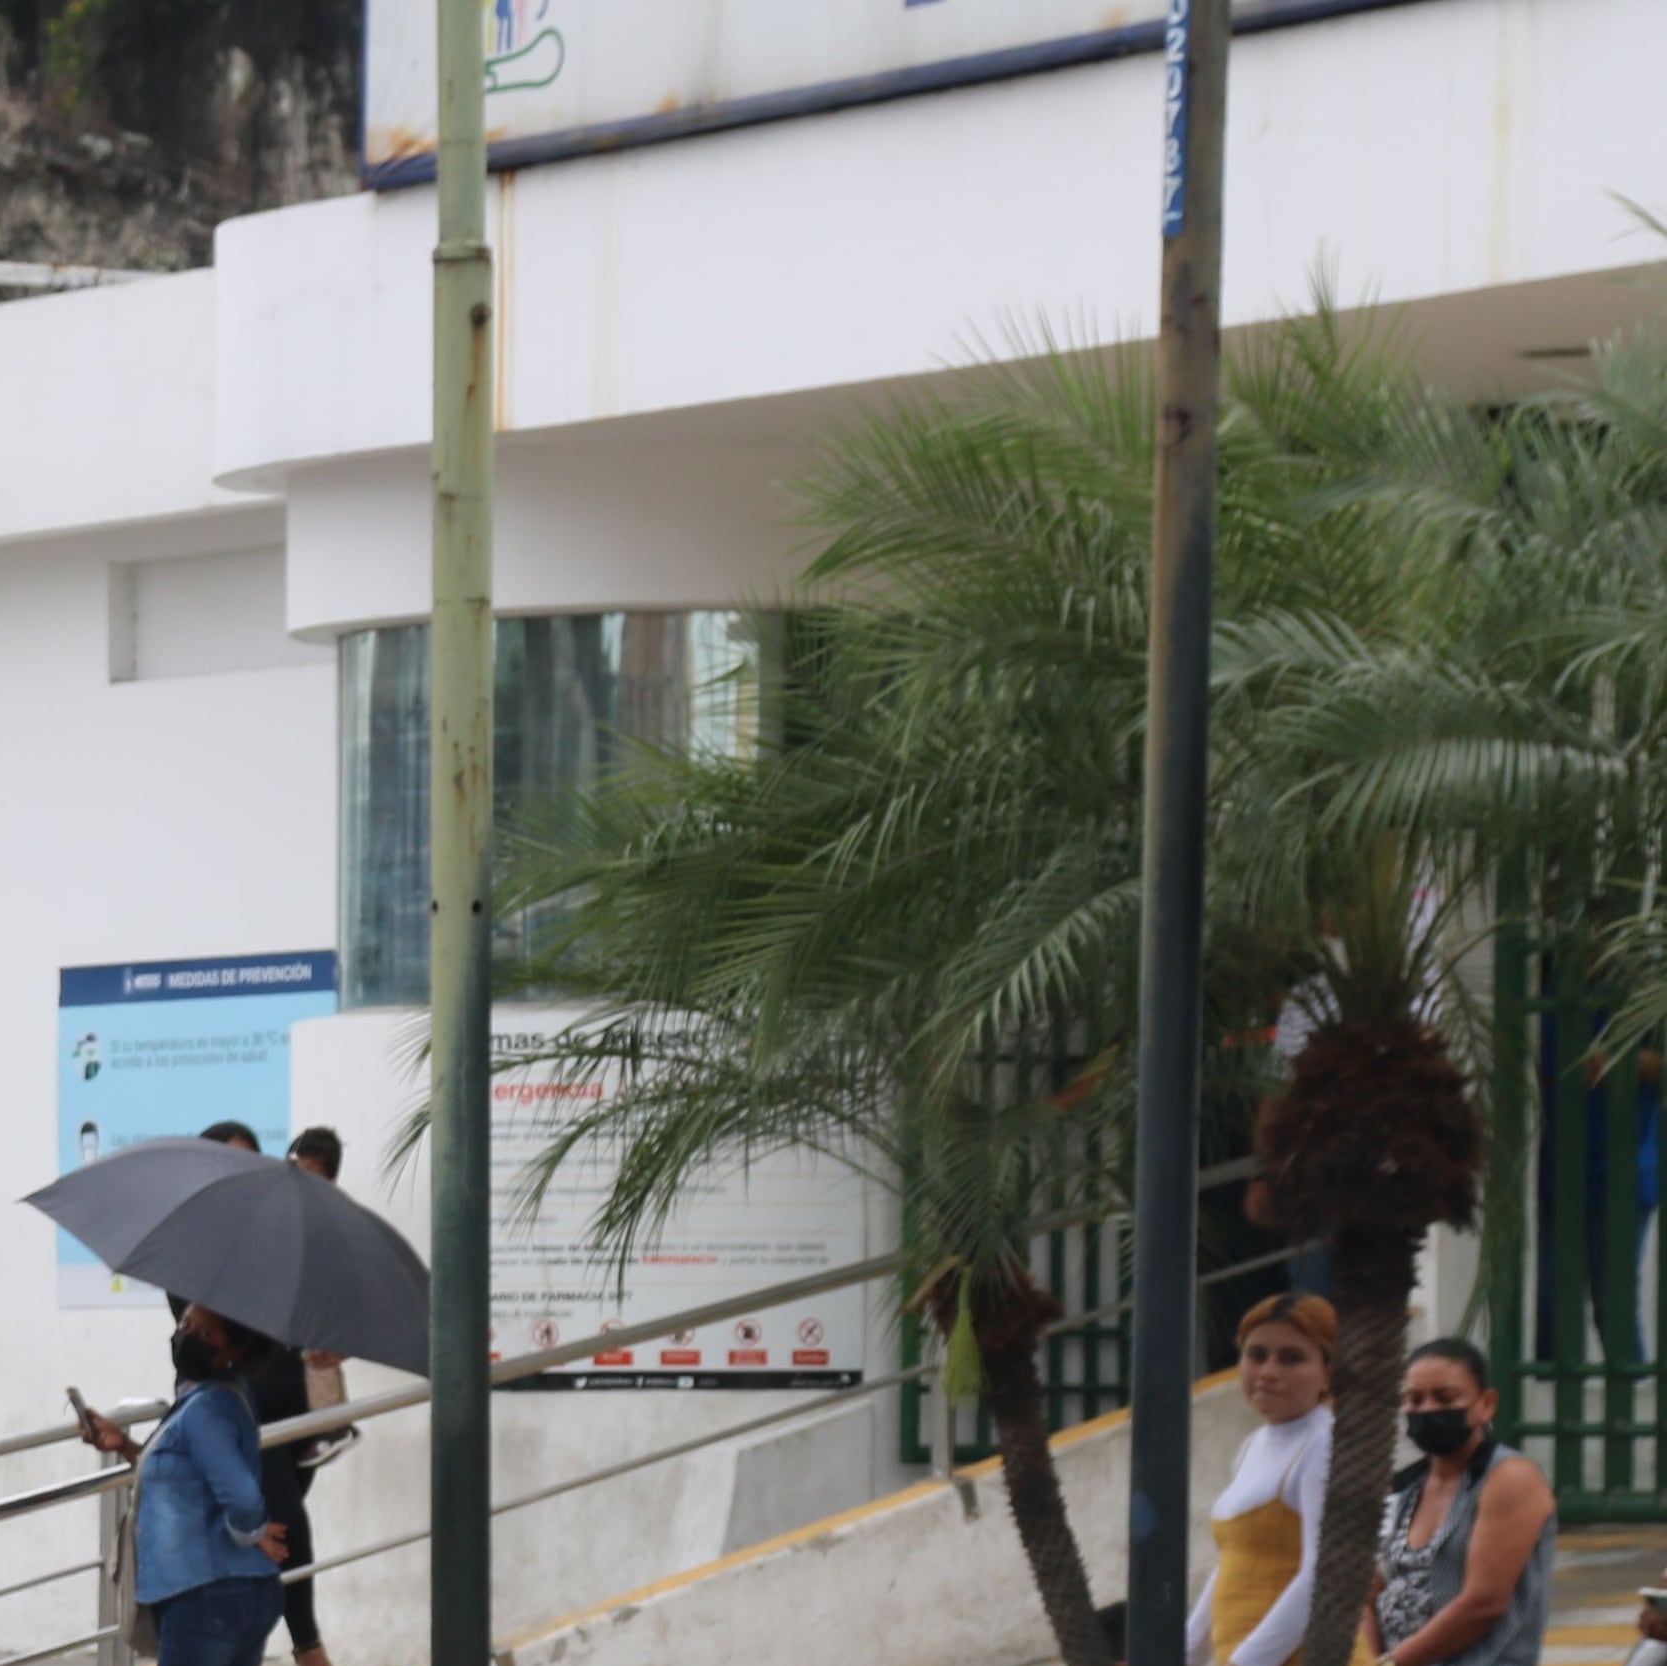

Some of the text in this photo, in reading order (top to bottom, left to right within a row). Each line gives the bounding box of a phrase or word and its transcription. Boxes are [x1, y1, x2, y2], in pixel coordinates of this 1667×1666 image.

[168, 970, 219, 989] MEDIDAS
[221, 969, 236, 986] DE
[239, 963, 313, 985] PREVENCIÓN
[491, 1033, 545, 1050] mas
[493, 1079, 605, 1104] ergencia
[491, 1292, 518, 1302] ARIO
